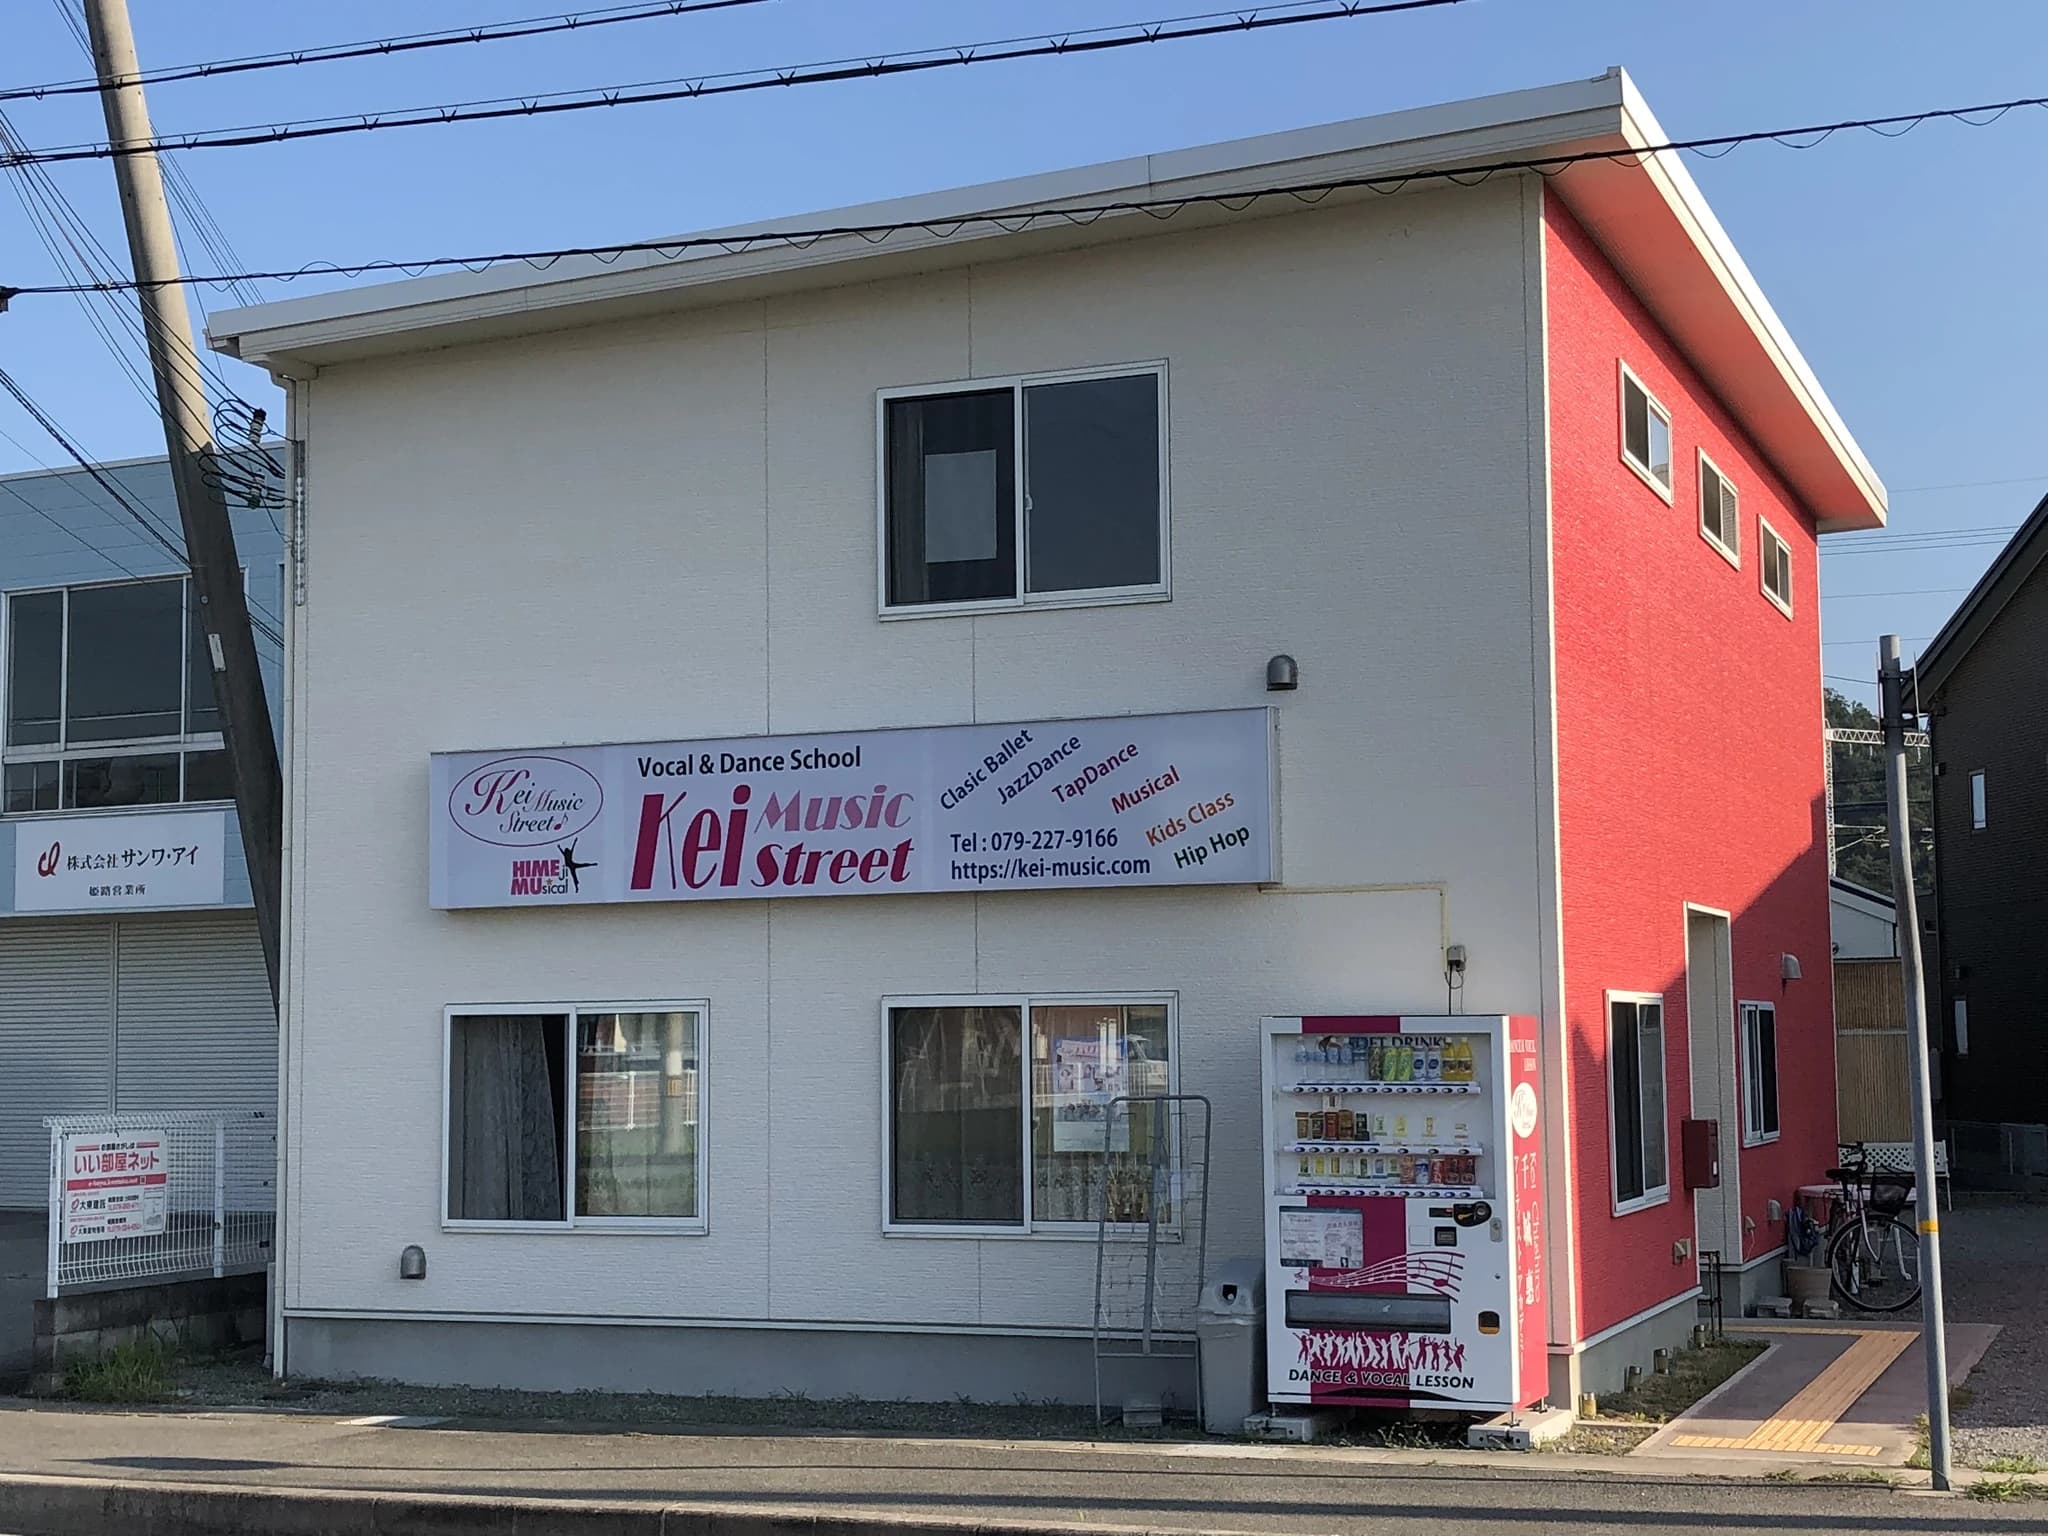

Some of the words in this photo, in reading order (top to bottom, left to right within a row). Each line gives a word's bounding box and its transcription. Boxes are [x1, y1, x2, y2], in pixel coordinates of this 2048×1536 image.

[638, 753, 694, 778] Vocal
[699, 754, 715, 775] &
[720, 750, 785, 774] Dance
[790, 745, 861, 770] School
[939, 766, 987, 811] Clasic
[983, 728, 1034, 774] Ballet
[997, 734, 1082, 805] JazzDance
[1051, 741, 1139, 804] TapDance
[464, 768, 537, 816] Kei
[525, 789, 584, 813] Music
[1110, 765, 1180, 815] Musical
[499, 813, 555, 834] Street
[630, 784, 752, 890] Kei
[753, 784, 914, 833] Music
[991, 828, 1119, 851] 079-227-9166
[1145, 816, 1187, 848] Kids
[1187, 791, 1236, 826] Class
[950, 857, 1151, 882] https://kei-music.com
[1173, 843, 1208, 870] Hip
[1209, 823, 1251, 854] Hop
[74, 1150, 160, 1175] いい部屋ネット
[1289, 1369, 1341, 1384] DANCE
[1361, 1371, 1411, 1387] VOCAL
[1416, 1374, 1475, 1390] LESSON
